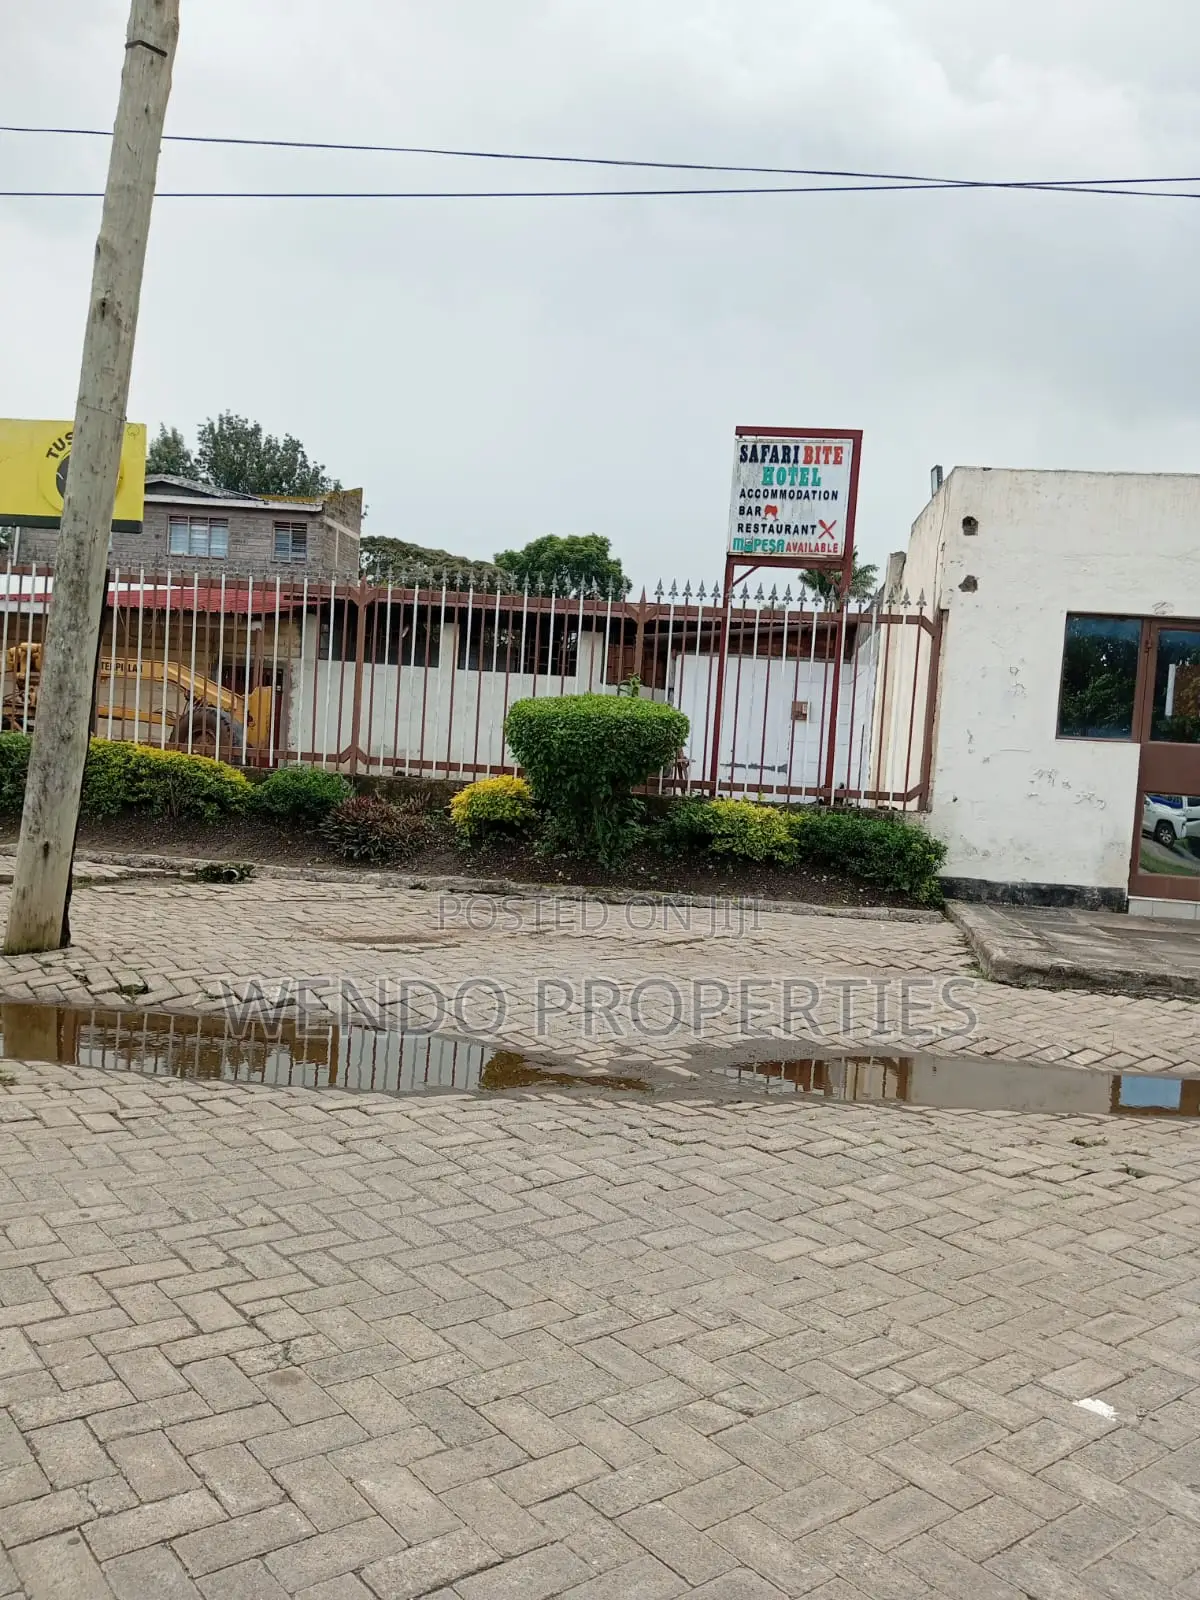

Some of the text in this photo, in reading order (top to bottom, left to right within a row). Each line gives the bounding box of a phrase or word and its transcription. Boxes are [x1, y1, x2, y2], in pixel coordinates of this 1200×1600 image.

[739, 444, 844, 465] SAFARI BITE
[761, 466, 822, 487] HOTEL
[739, 488, 839, 501] ACCOMMODATION
[738, 505, 762, 516] BAR
[737, 523, 817, 535] RESTAURANT
[785, 541, 839, 554] AVAILABLE
